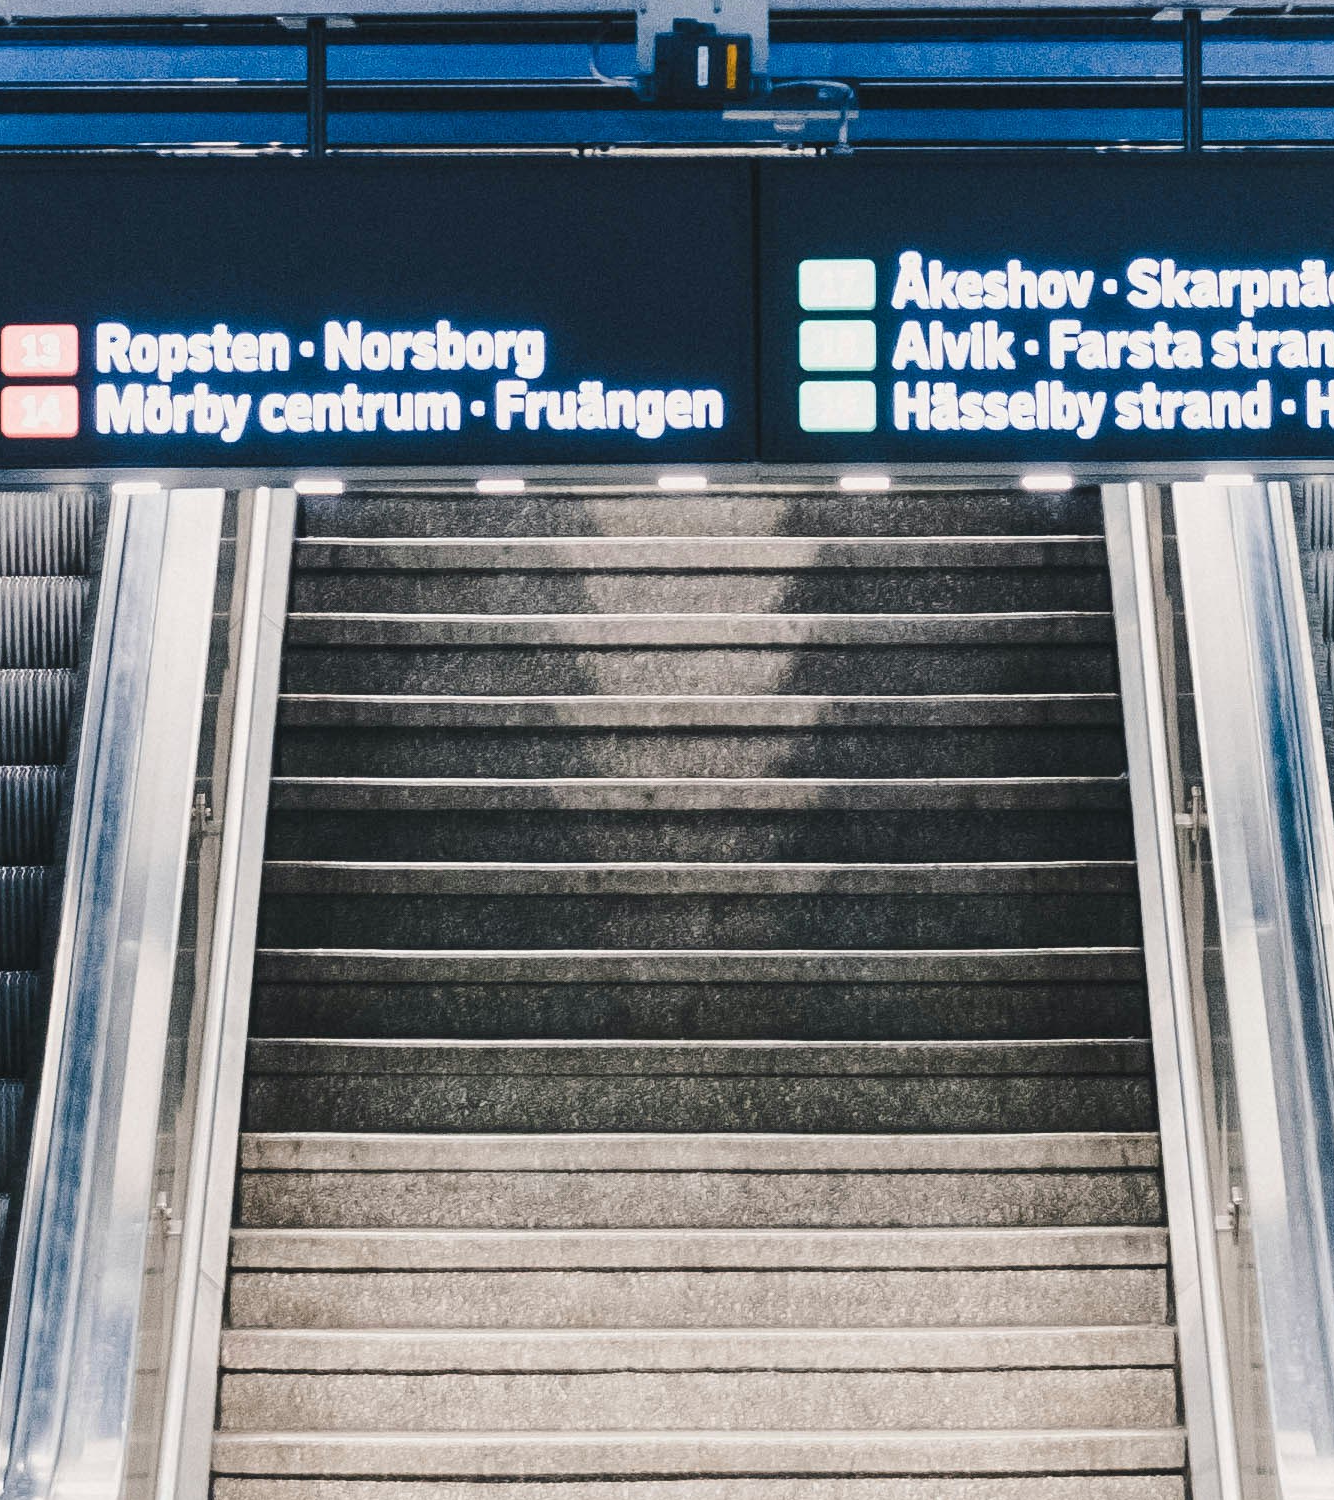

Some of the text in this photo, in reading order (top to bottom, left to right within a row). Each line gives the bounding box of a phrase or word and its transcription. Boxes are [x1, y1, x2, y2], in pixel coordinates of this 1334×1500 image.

[890, 250, 1095, 310] Åkeshov
[95, 322, 290, 381] Ropsten
[324, 320, 546, 379] Norsborg
[891, 319, 1017, 370] Alvik
[1049, 319, 1204, 370] Farsta
[94, 383, 253, 442] Mörby
[258, 382, 462, 434] centrum
[495, 378, 724, 439] Fruängen
[893, 380, 1108, 440] Hässelby
[1114, 380, 1272, 431] strand
